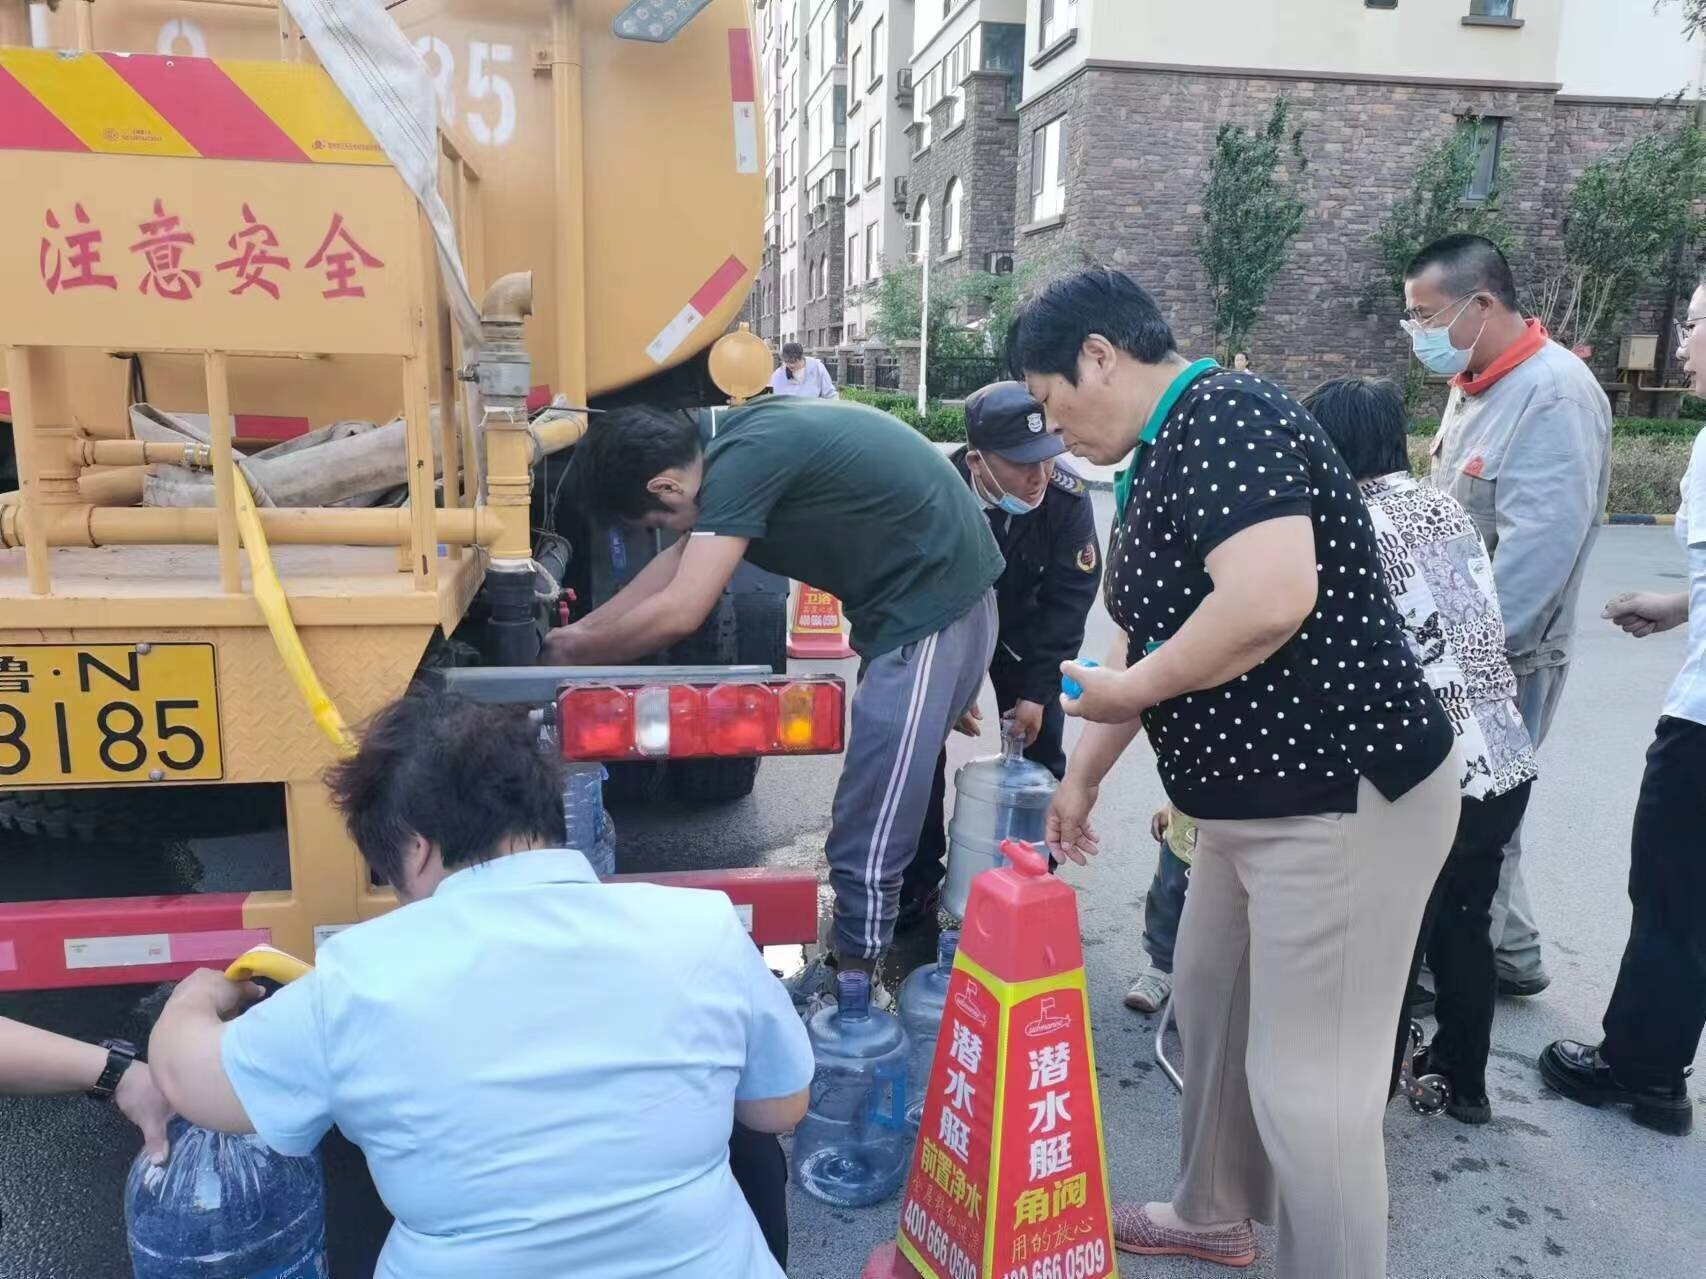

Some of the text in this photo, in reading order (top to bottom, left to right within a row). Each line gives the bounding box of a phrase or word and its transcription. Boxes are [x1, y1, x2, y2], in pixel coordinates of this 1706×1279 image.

[38, 198, 385, 301] 注意安全
[938, 1019, 983, 1164] 潜水艇
[1028, 1041, 1073, 1182] 潜水艇
[921, 1137, 982, 1224] 前置净水
[1013, 1172, 1087, 1231] 角阀
[905, 1199, 926, 1243] 400
[927, 1219, 949, 1267] 666
[1012, 1216, 1094, 1264] 用的放心
[1065, 1238, 1105, 1279] 0509
